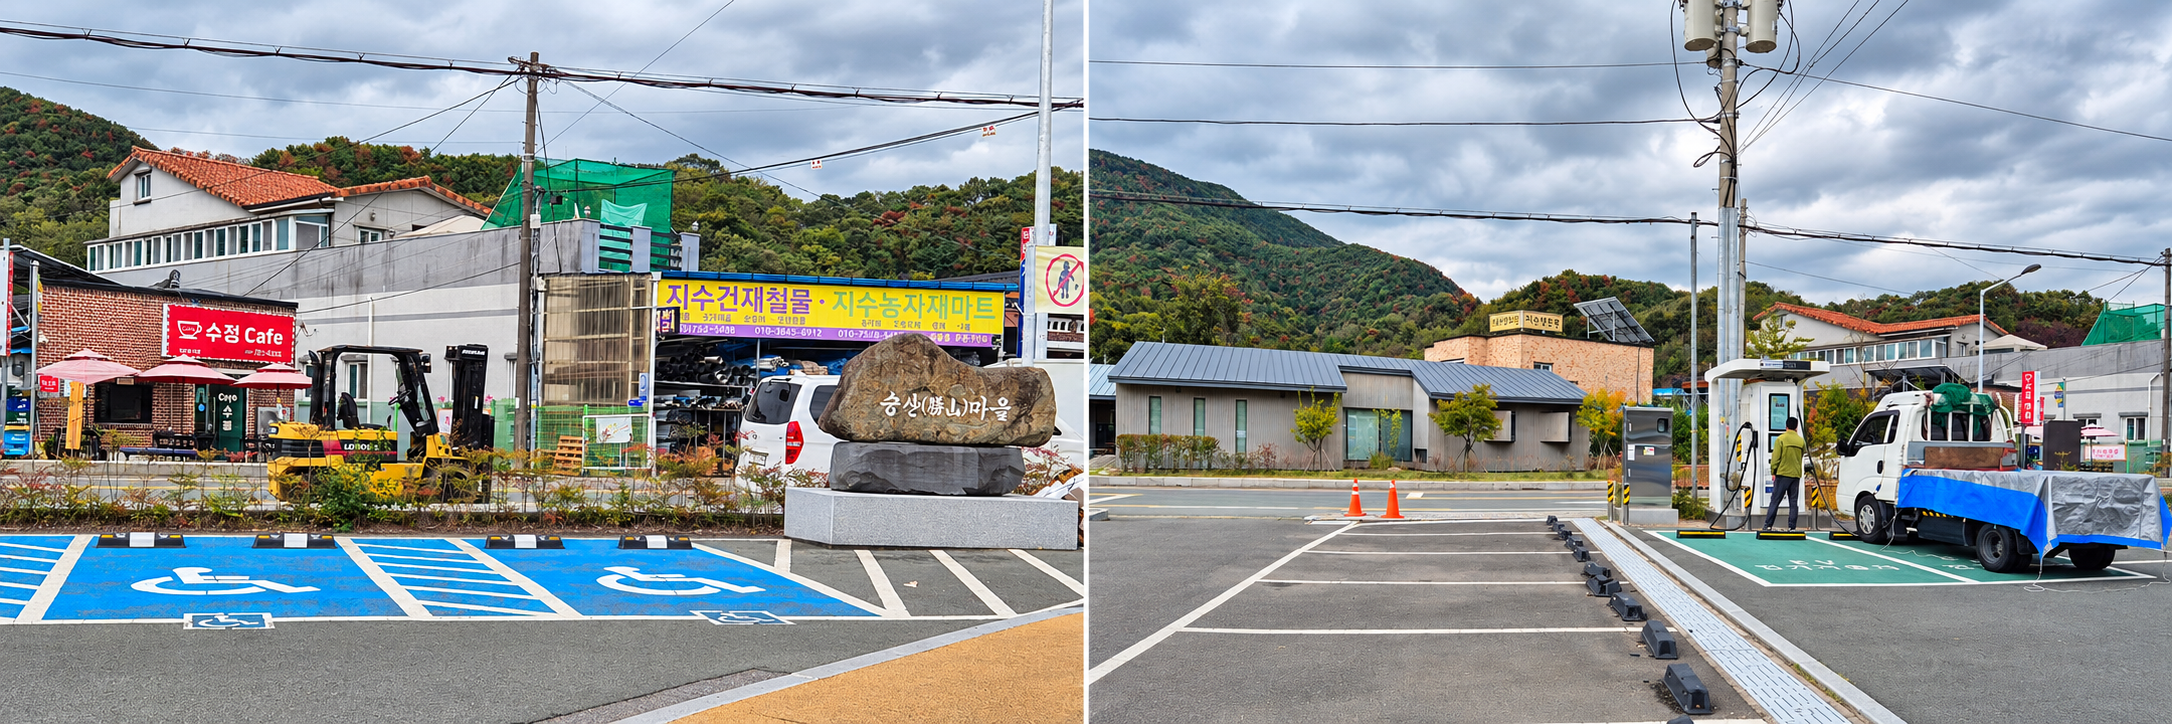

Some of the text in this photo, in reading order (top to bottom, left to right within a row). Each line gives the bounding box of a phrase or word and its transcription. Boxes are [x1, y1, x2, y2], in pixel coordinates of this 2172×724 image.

[666, 284, 812, 315] 지수건재철물
[832, 291, 996, 321] 지수농자재마트
[205, 322, 283, 345] 수정 Cafe
[880, 391, 1012, 422] 승산(勝山)마을
